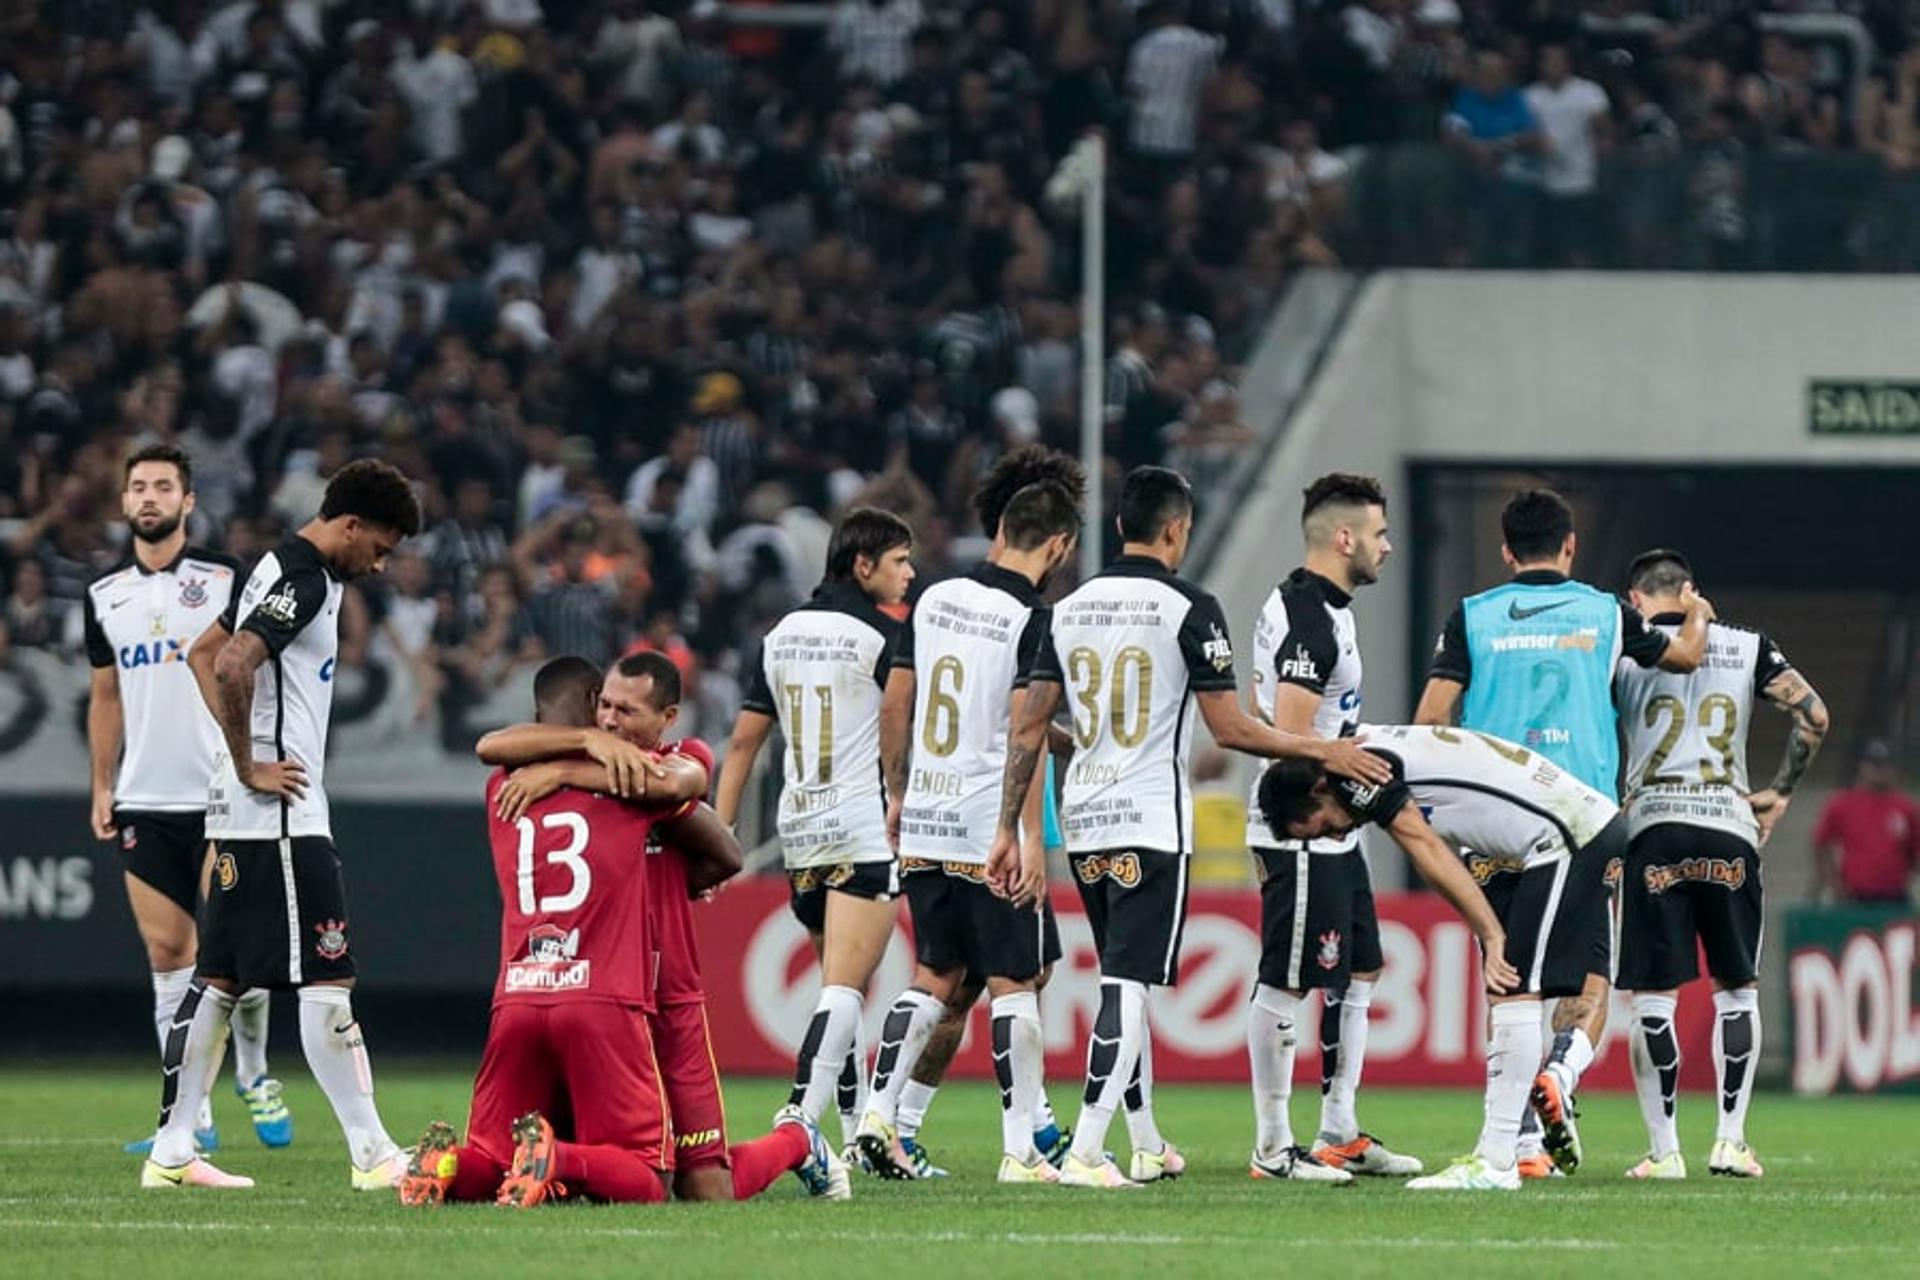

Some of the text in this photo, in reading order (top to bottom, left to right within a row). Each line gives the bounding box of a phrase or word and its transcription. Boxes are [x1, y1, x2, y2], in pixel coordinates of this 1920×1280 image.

[924, 654, 964, 757] 6
[1068, 646, 1153, 750] 30
[1282, 659, 1318, 679] FIEL
[785, 684, 833, 784] 11
[1543, 728, 1570, 744] TIM
[1642, 693, 1737, 786] 23
[517, 811, 591, 915] 13
